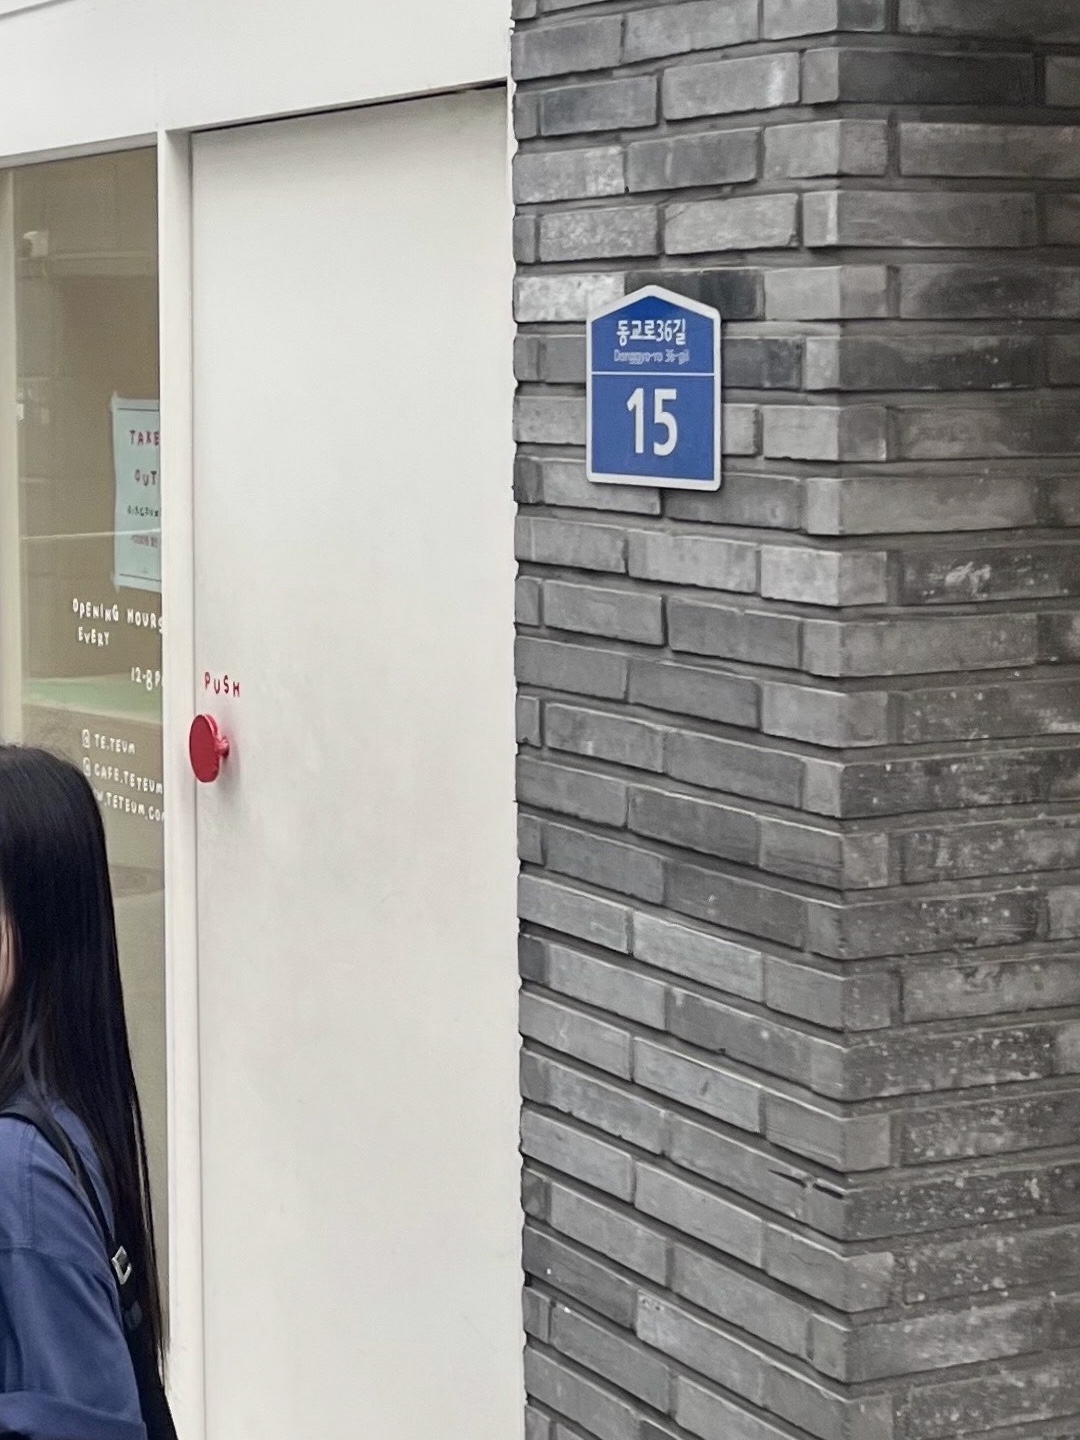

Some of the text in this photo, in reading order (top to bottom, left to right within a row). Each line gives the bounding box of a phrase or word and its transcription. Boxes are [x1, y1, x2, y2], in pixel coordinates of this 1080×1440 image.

[616, 318, 686, 346] 동교로36길
[613, 348, 664, 365] Donggyo-ro
[626, 387, 678, 457] 15
[129, 429, 160, 447] TAKE
[134, 468, 158, 487] OUT
[72, 598, 120, 623] OPENING
[77, 626, 110, 648] EVERY
[204, 671, 241, 698] PUSH
